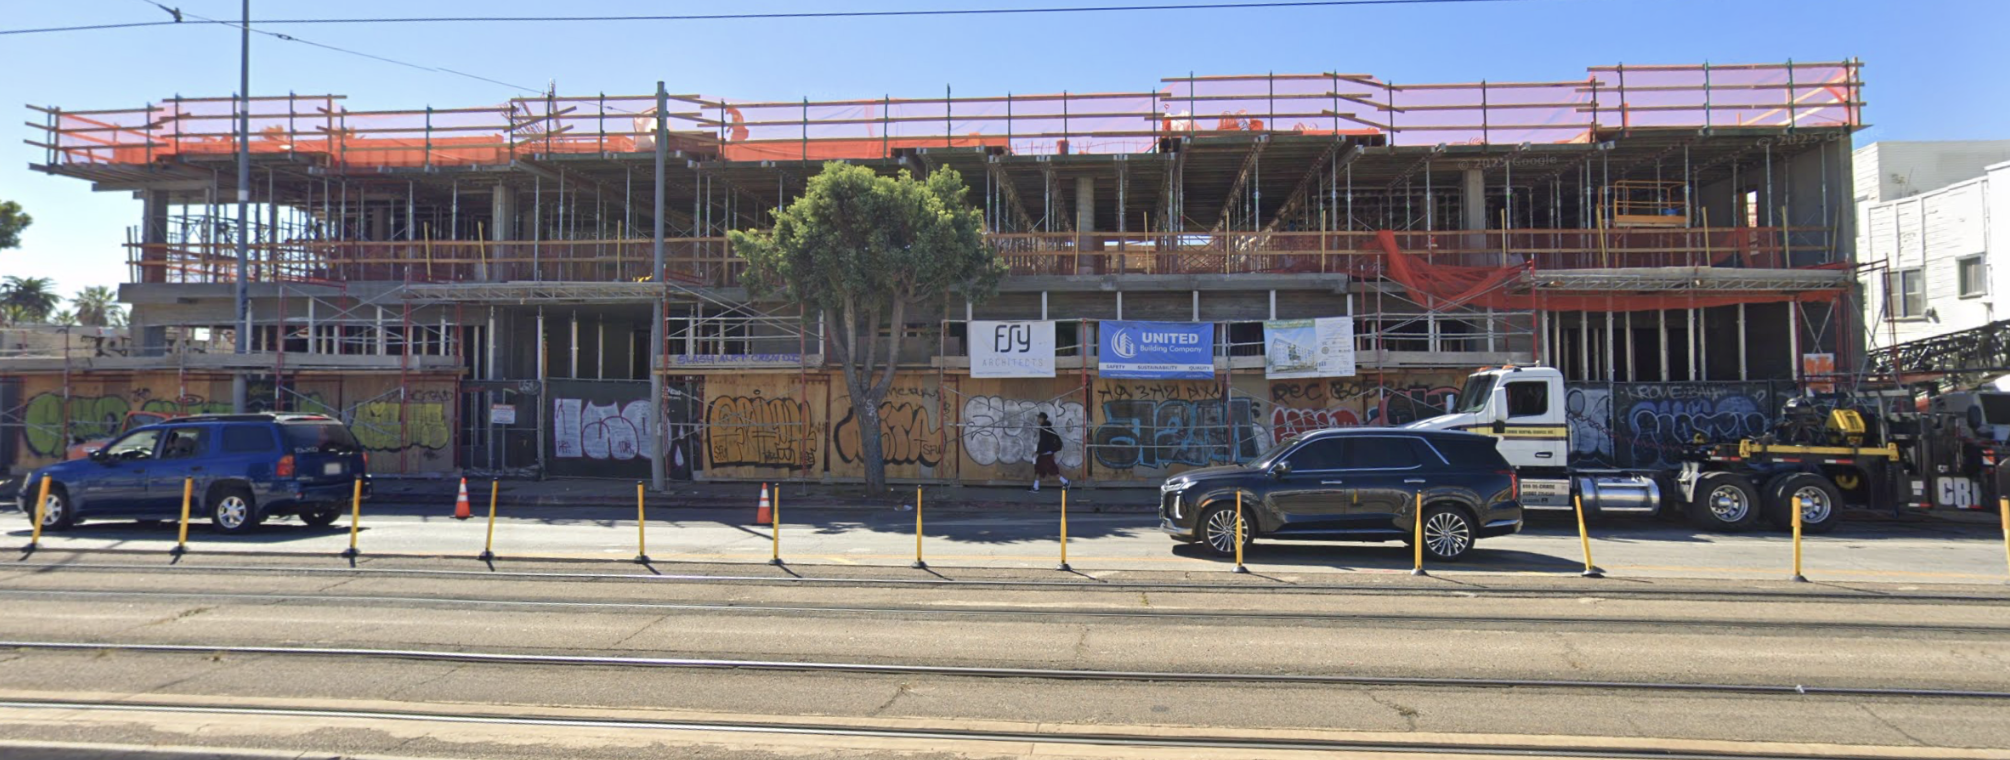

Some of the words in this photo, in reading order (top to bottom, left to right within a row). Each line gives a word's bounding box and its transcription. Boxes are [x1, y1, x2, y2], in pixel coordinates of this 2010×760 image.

[1142, 332, 1199, 344] UNITED
[1140, 345, 1168, 353] Building
[1169, 345, 1202, 353] Company
[982, 358, 1043, 367] ARCHITECTS
